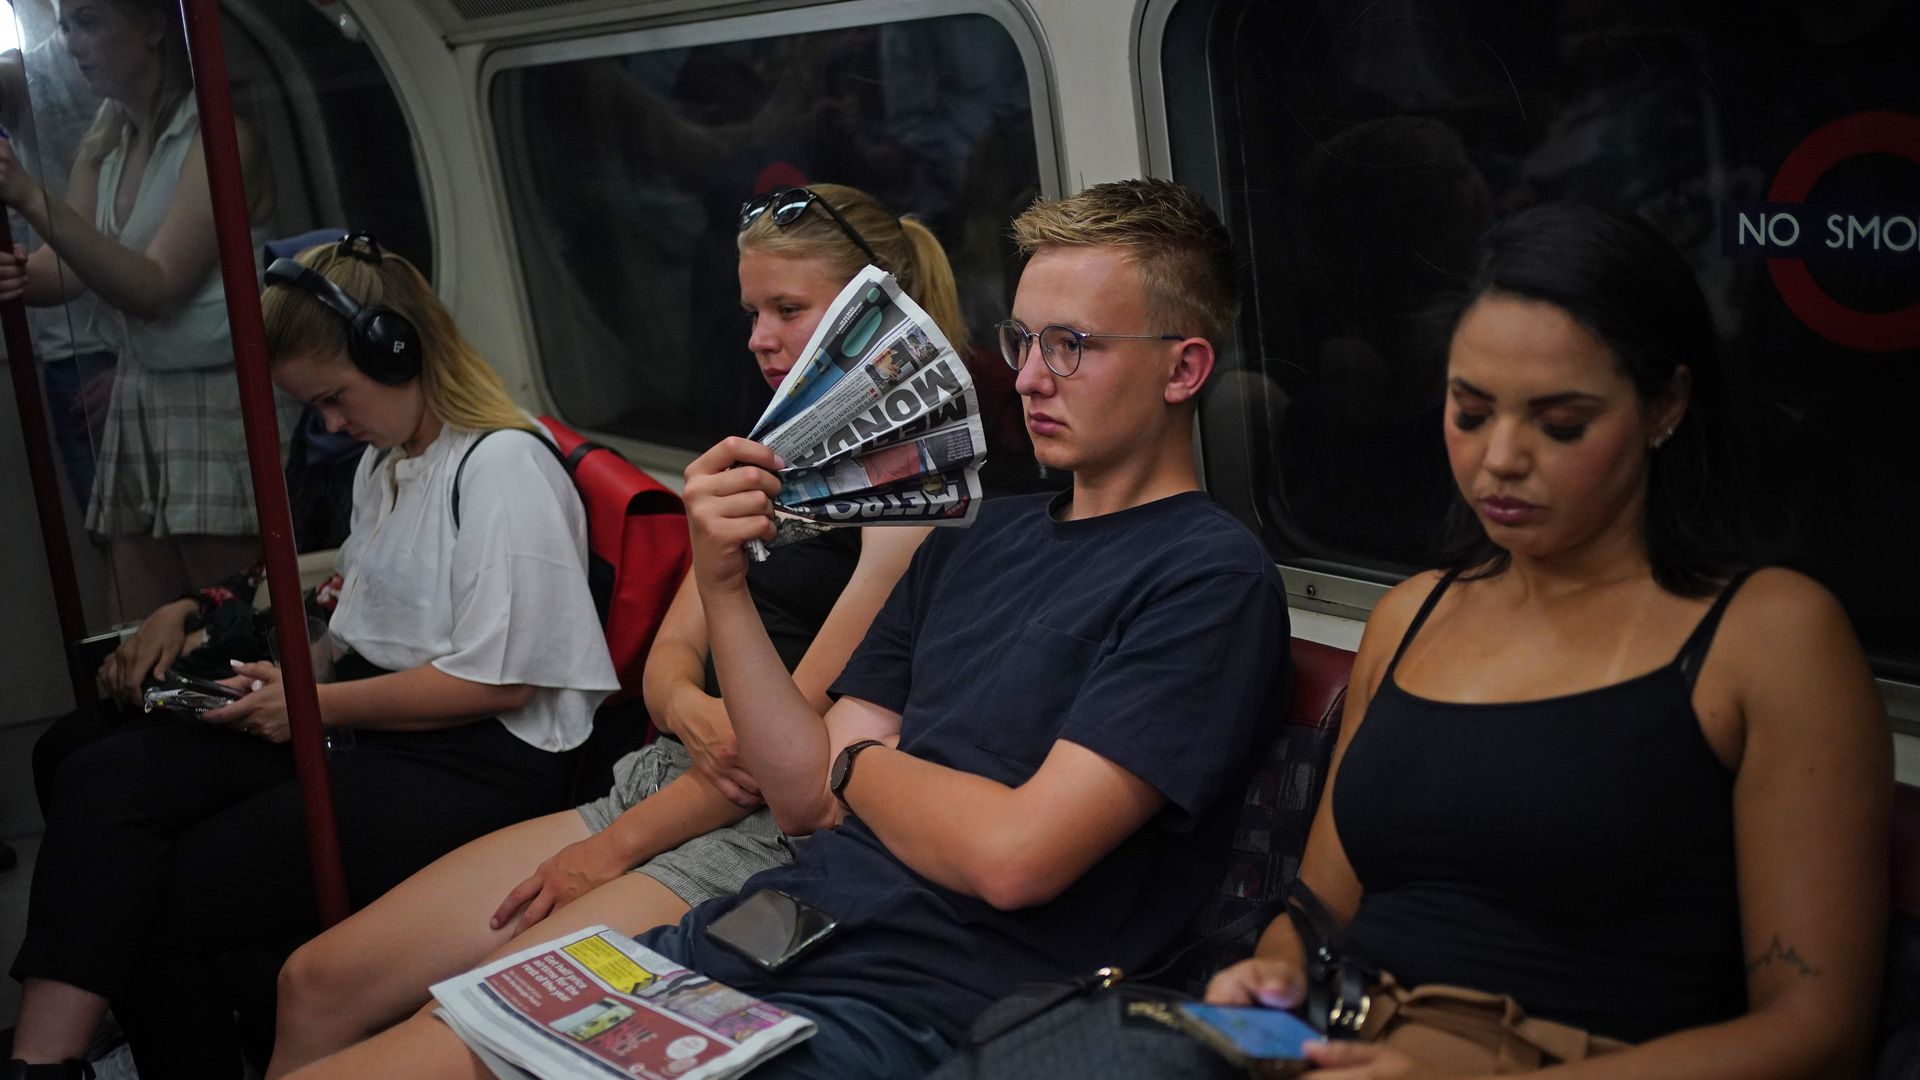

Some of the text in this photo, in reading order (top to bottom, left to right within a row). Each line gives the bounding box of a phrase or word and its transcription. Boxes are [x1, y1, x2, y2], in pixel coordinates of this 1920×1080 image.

[1739, 212, 1920, 253] NO SMO
[789, 359, 962, 467] MONDA
[825, 483, 961, 521] METRO
